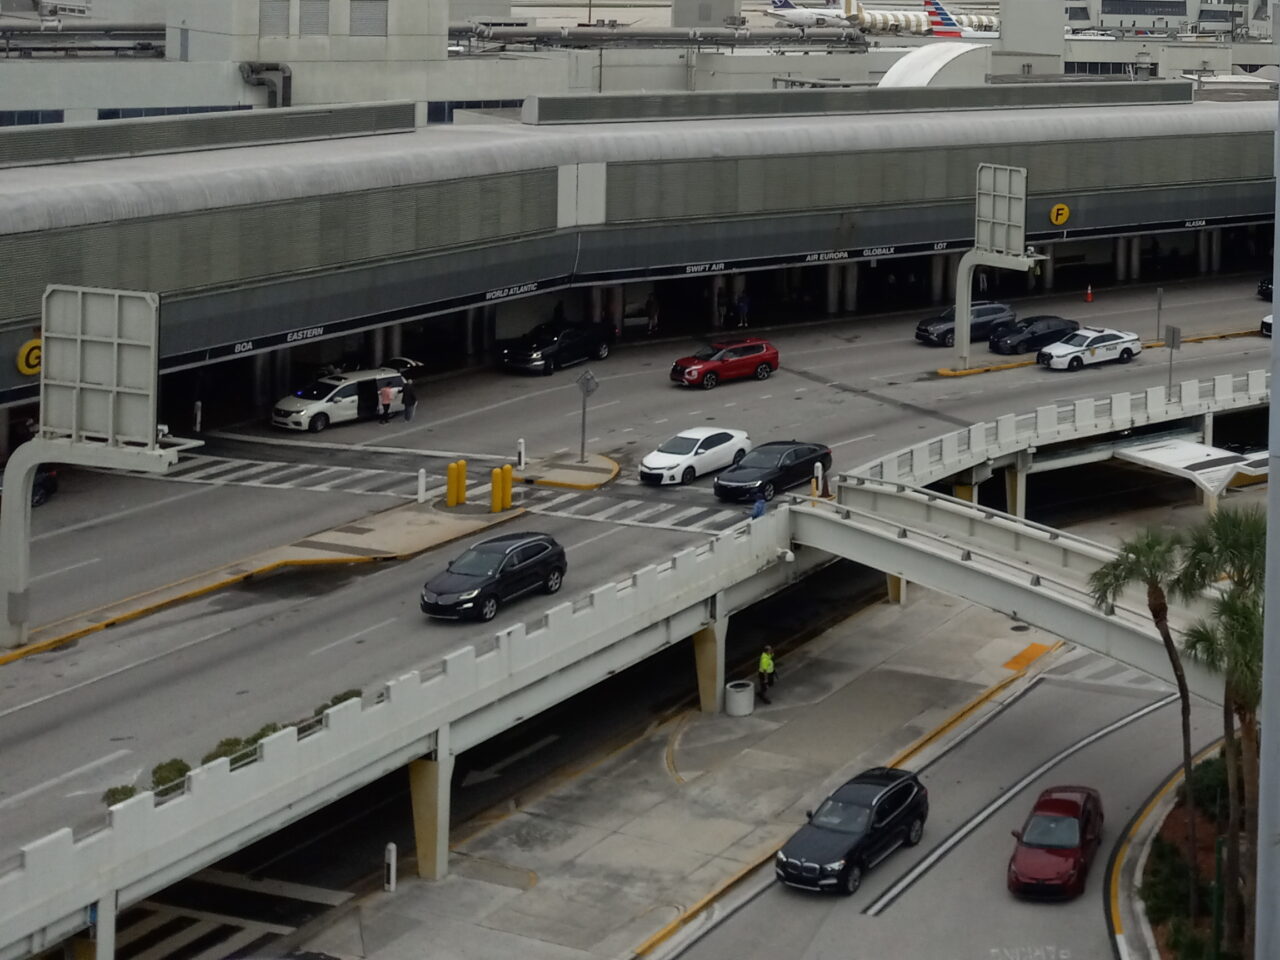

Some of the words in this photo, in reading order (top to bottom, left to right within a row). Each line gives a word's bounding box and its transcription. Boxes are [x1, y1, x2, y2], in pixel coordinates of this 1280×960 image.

[1184, 220, 1206, 228] ALASKA
[863, 247, 895, 256] GLOBALX
[934, 242, 948, 250] LOT
[805, 253, 818, 262] AIR
[819, 251, 849, 261] EUROPA
[686, 264, 710, 274] SWIFT
[711, 262, 725, 271] AIR
[485, 287, 509, 300] WORLD
[508, 282, 538, 295] ATLANTIC
[287, 327, 324, 342] EASTERN
[234, 341, 254, 353] BOA
[25, 345, 42, 369] G
